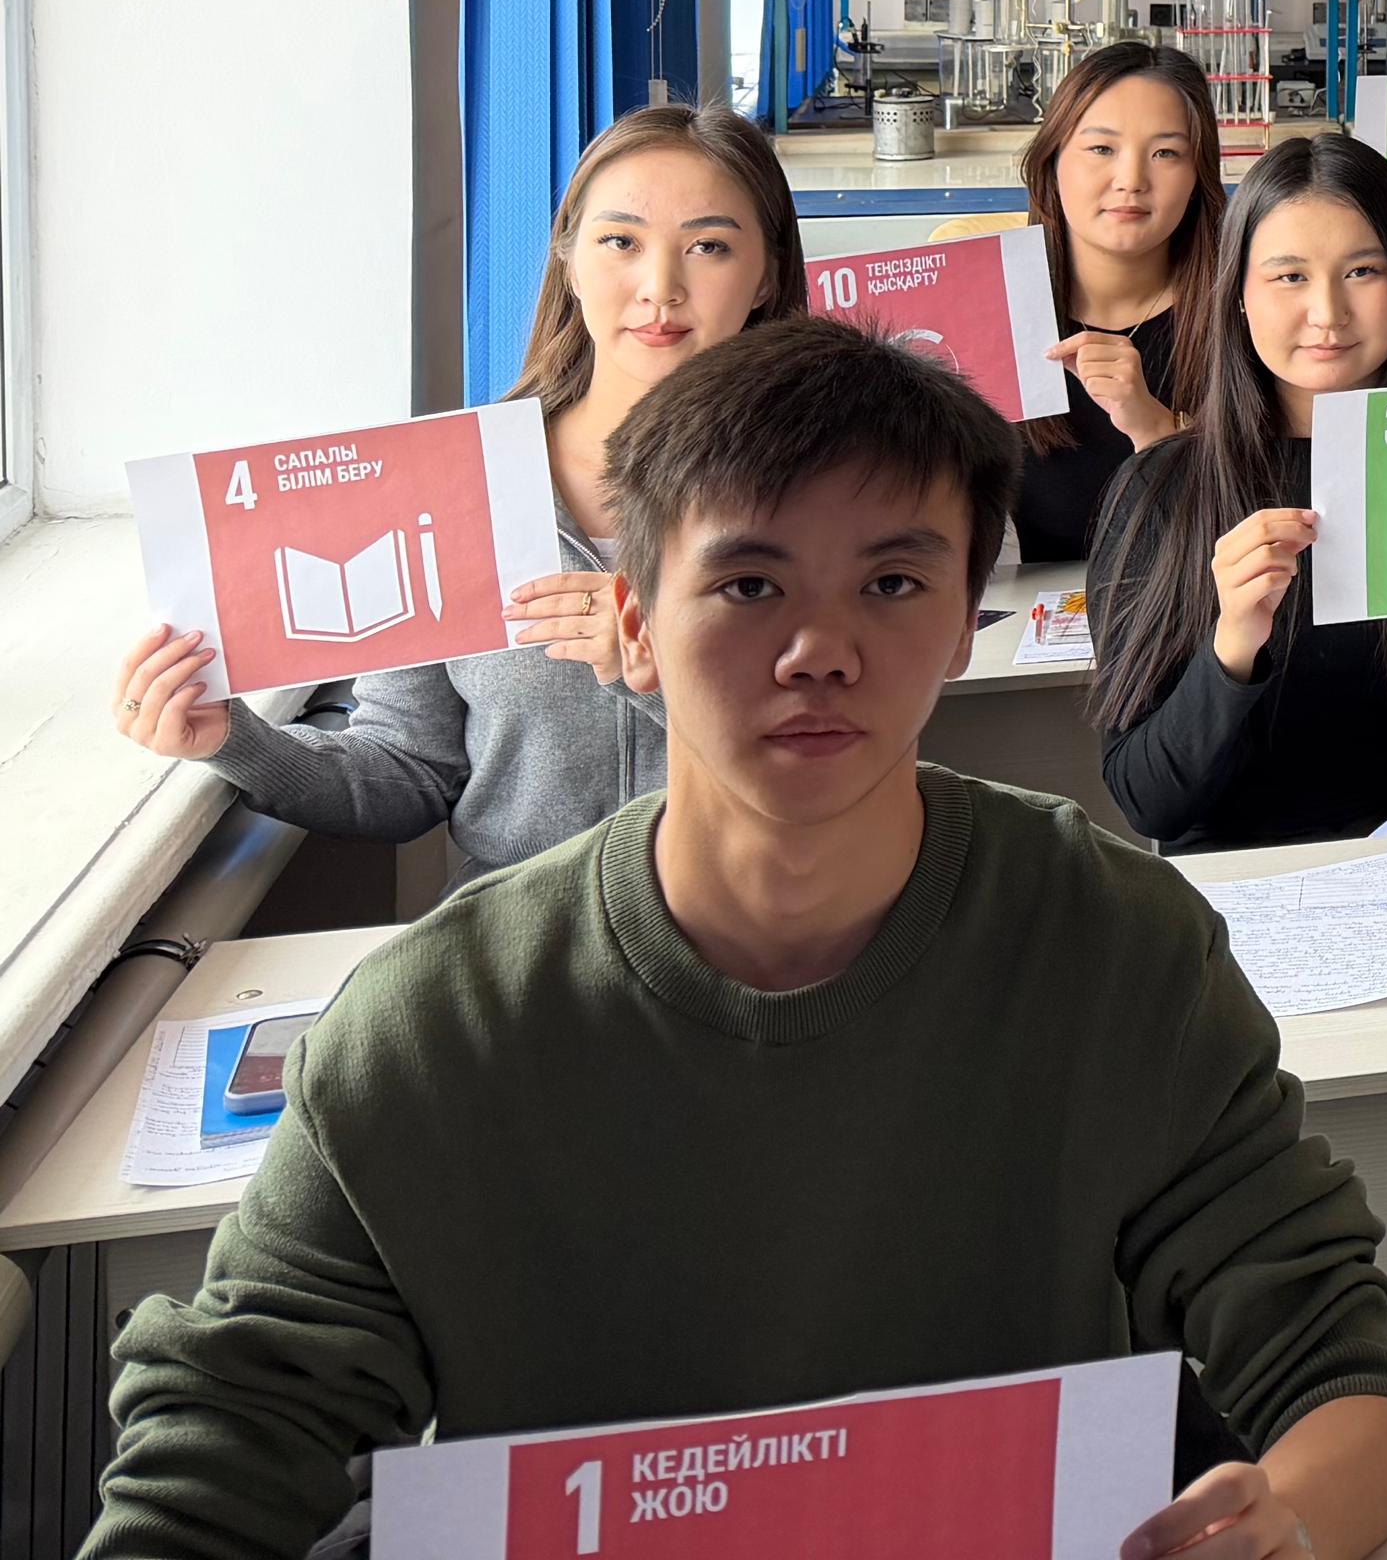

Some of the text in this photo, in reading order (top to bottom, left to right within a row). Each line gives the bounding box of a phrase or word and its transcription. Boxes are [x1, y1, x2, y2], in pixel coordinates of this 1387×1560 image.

[865, 253, 946, 278] ТЕҢСІЗДІКТІ
[867, 270, 939, 297] ҚЫСҚАРТУ
[818, 267, 858, 311] 10
[274, 444, 358, 471] САПАЛЫ
[277, 460, 383, 492] БІЛІМ БЕРУ
[225, 460, 258, 510] 4
[632, 1428, 847, 1483] КЕДЕЙЛІКТІ
[565, 1460, 602, 1555] 1
[629, 1481, 729, 1523] ЖОЮ
